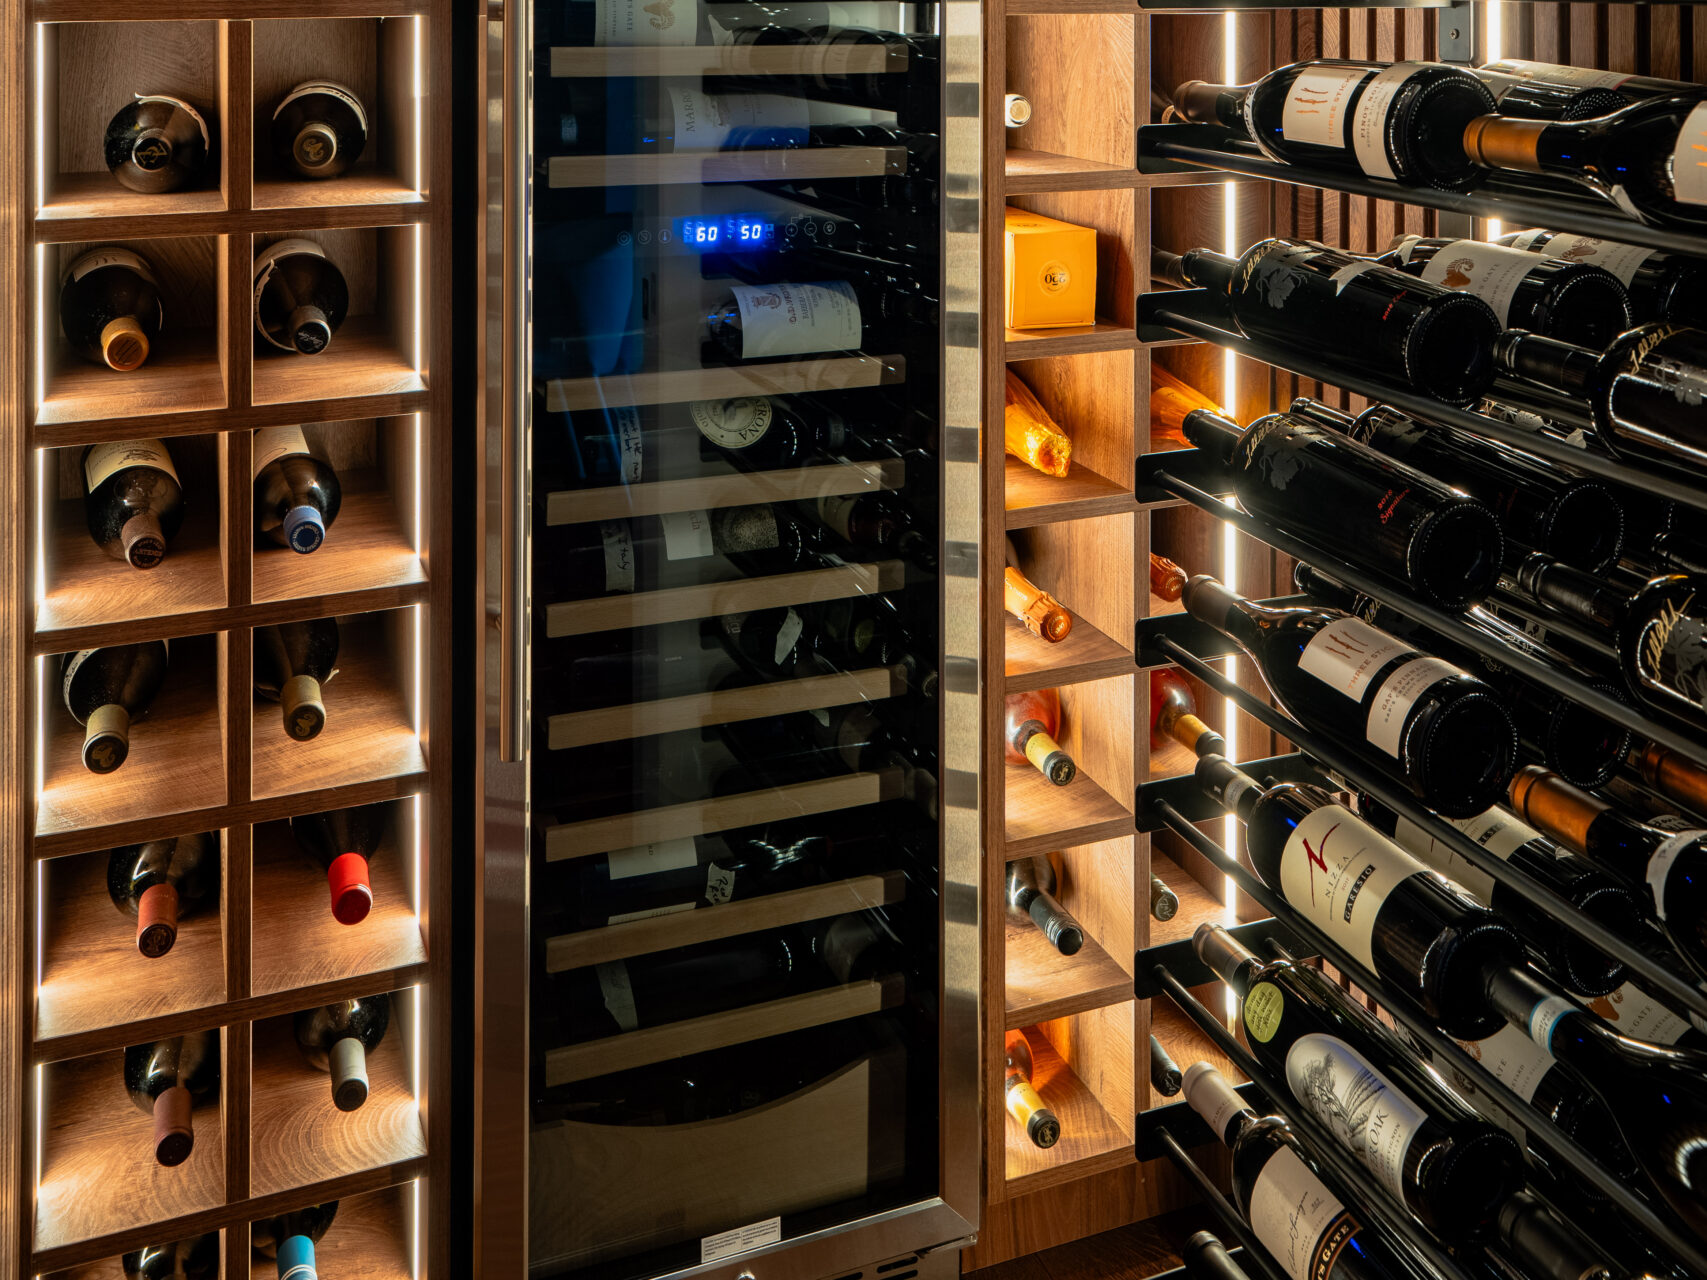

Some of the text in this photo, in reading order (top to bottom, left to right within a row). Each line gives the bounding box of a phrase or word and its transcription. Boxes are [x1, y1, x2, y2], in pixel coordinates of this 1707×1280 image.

[1328, 108, 1338, 142] THREE
[1359, 106, 1369, 138] PINOT
[697, 224, 762, 243] 60 50
[1348, 658, 1371, 690] THREE
[1324, 855, 1351, 900] NIZZA
[1344, 866, 1374, 921] GARESIO
[1368, 1109, 1389, 1148] OAK
[1322, 1224, 1350, 1263] GATE
